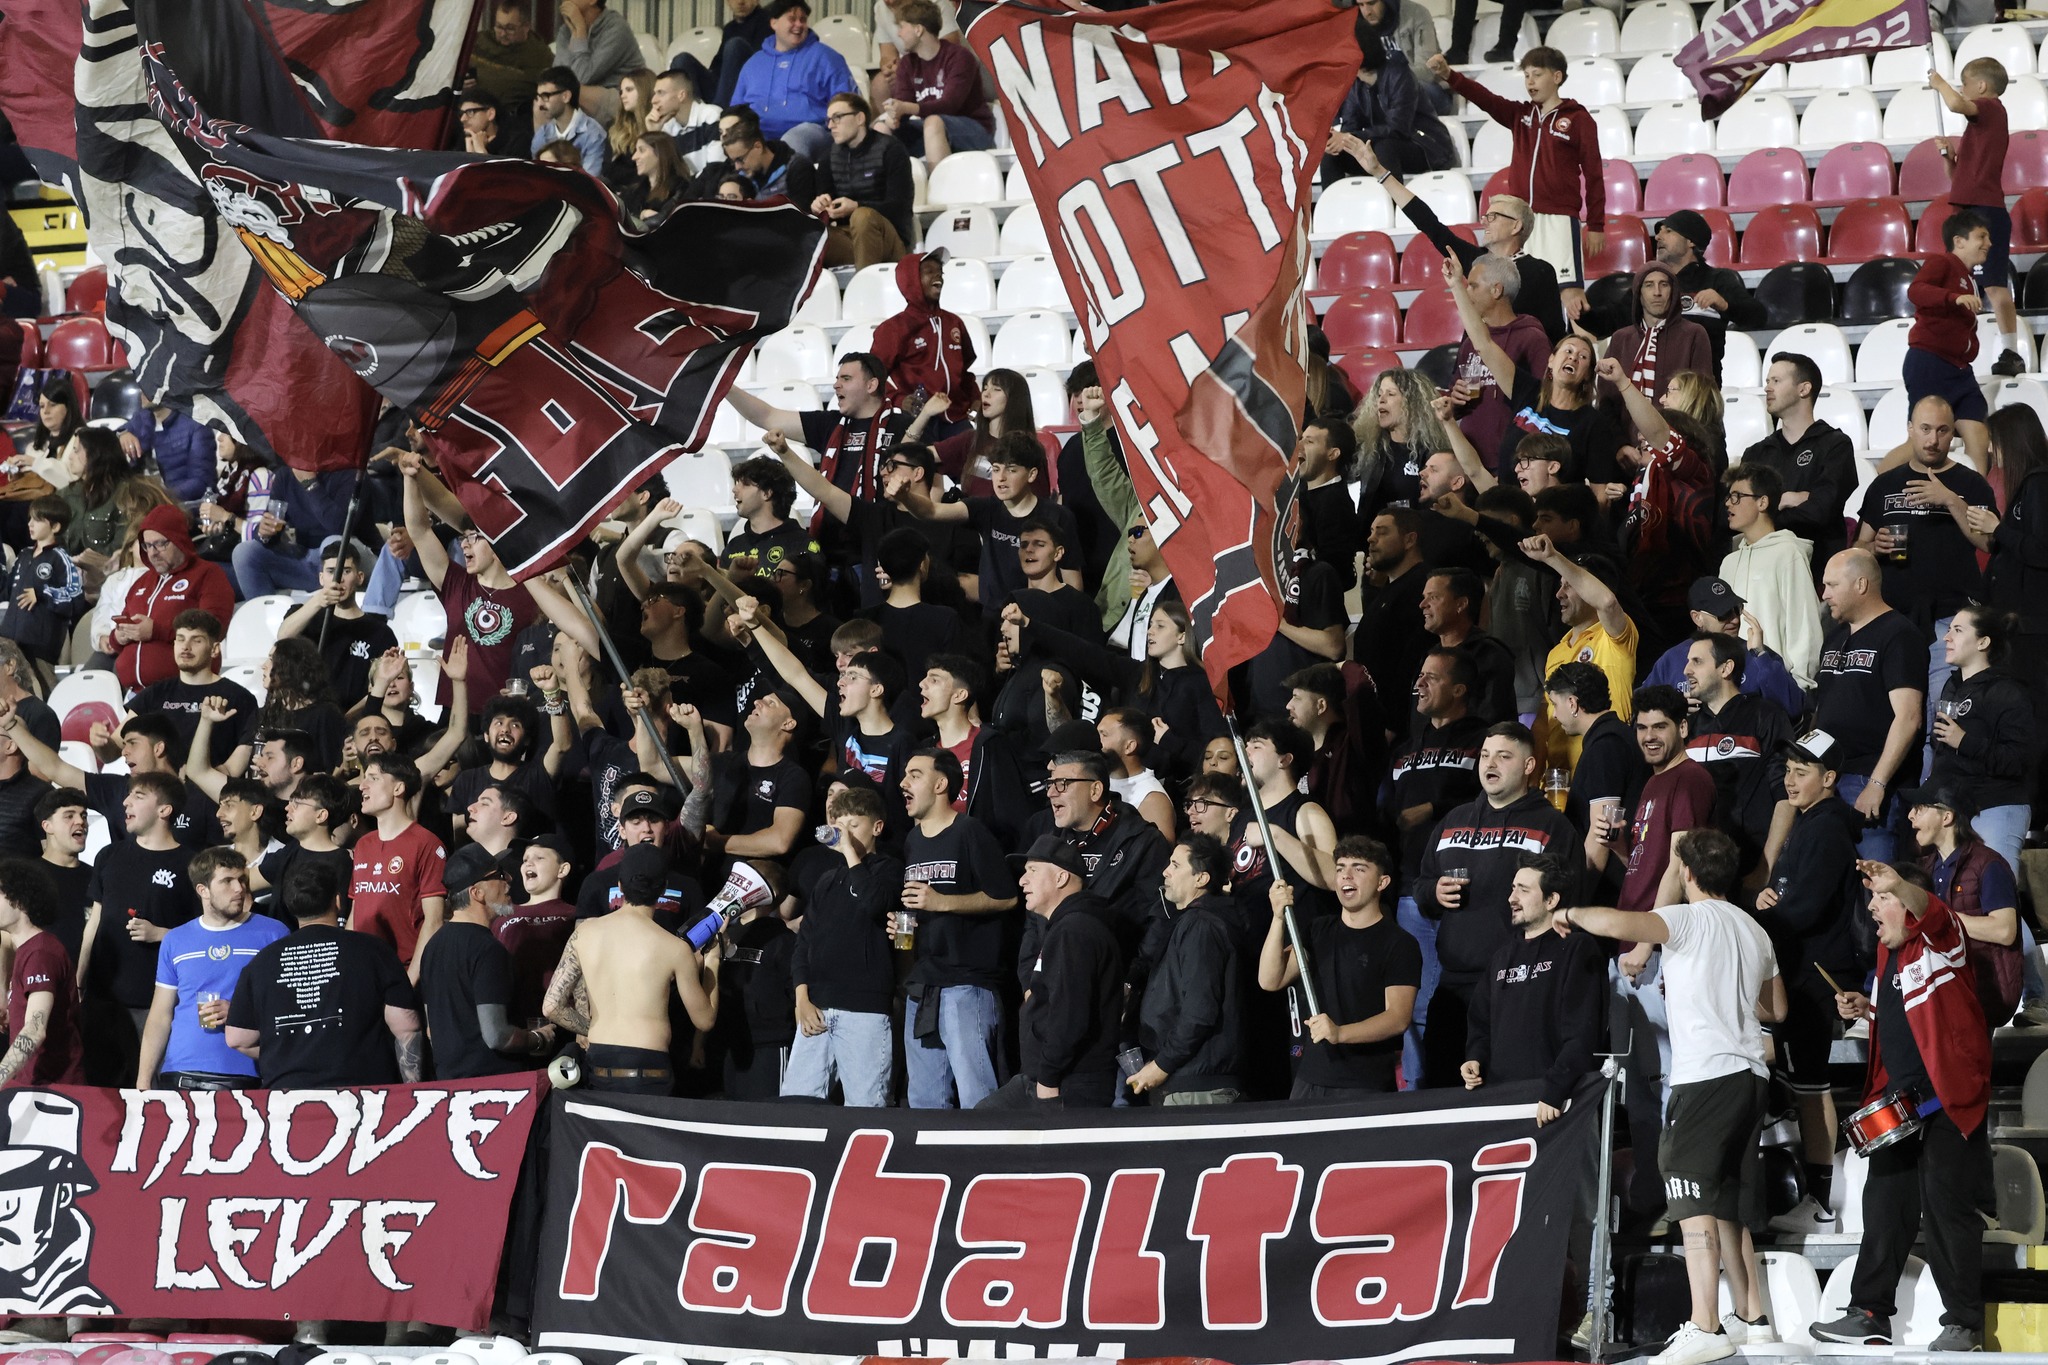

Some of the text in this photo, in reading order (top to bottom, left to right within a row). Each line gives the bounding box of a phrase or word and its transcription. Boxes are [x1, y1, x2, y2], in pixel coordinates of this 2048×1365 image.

[1402, 749, 1465, 770] RABALTAI
[1450, 829, 1528, 849] RABALTAI
[110, 1088, 529, 1190] NUOVE
[154, 1197, 437, 1292] LEVE
[559, 1128, 1538, 1331] rabaltai
